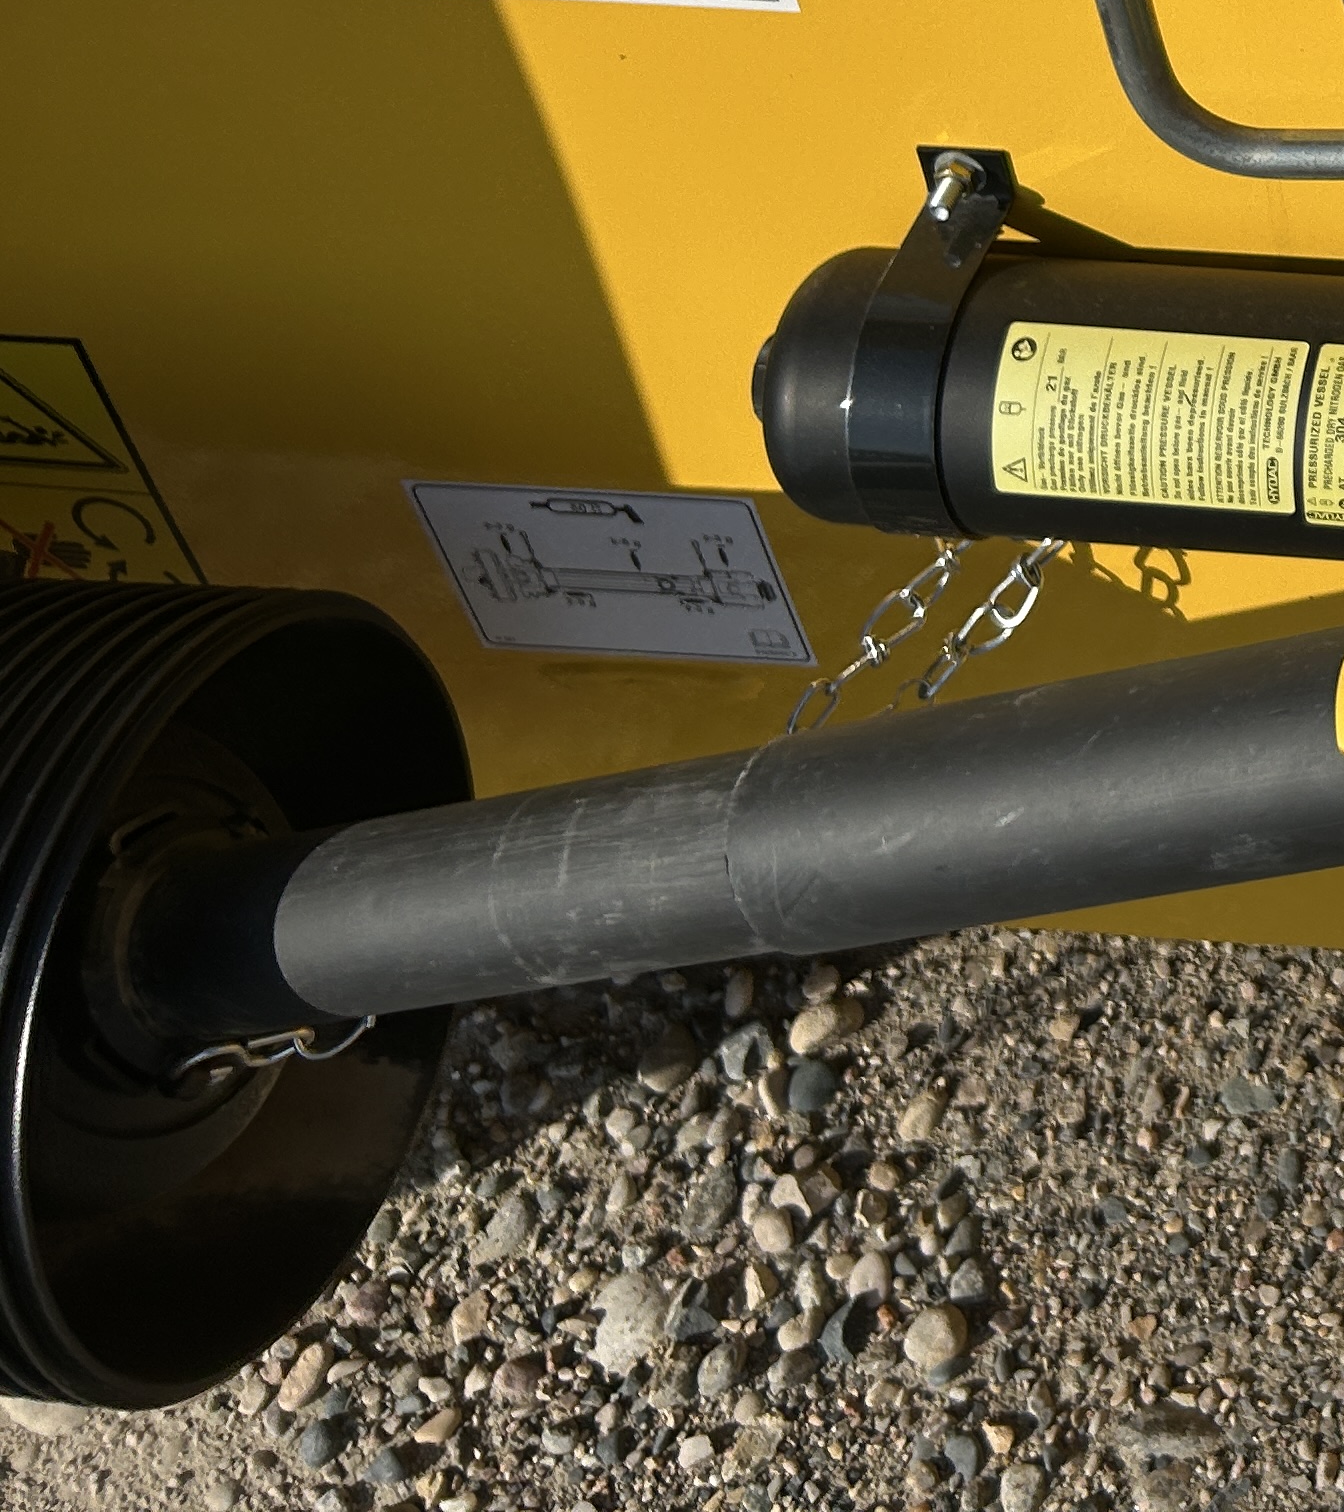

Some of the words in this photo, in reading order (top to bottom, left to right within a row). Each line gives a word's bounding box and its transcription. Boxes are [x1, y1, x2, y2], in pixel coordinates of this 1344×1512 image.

[1046, 375, 1058, 392] 21
[1163, 365, 1176, 402] VESSEL
[1314, 367, 1330, 407] VESSEL
[1328, 374, 1344, 415] NITROGEN
[1159, 405, 1170, 457] PRESSURE
[1263, 387, 1276, 449] TECHNOLOGY
[1325, 418, 1335, 435] DRY
[1308, 412, 1321, 488] PRESSURIZED
[1323, 437, 1334, 490] PRECHARGED
[1267, 457, 1279, 503] HYDAC
